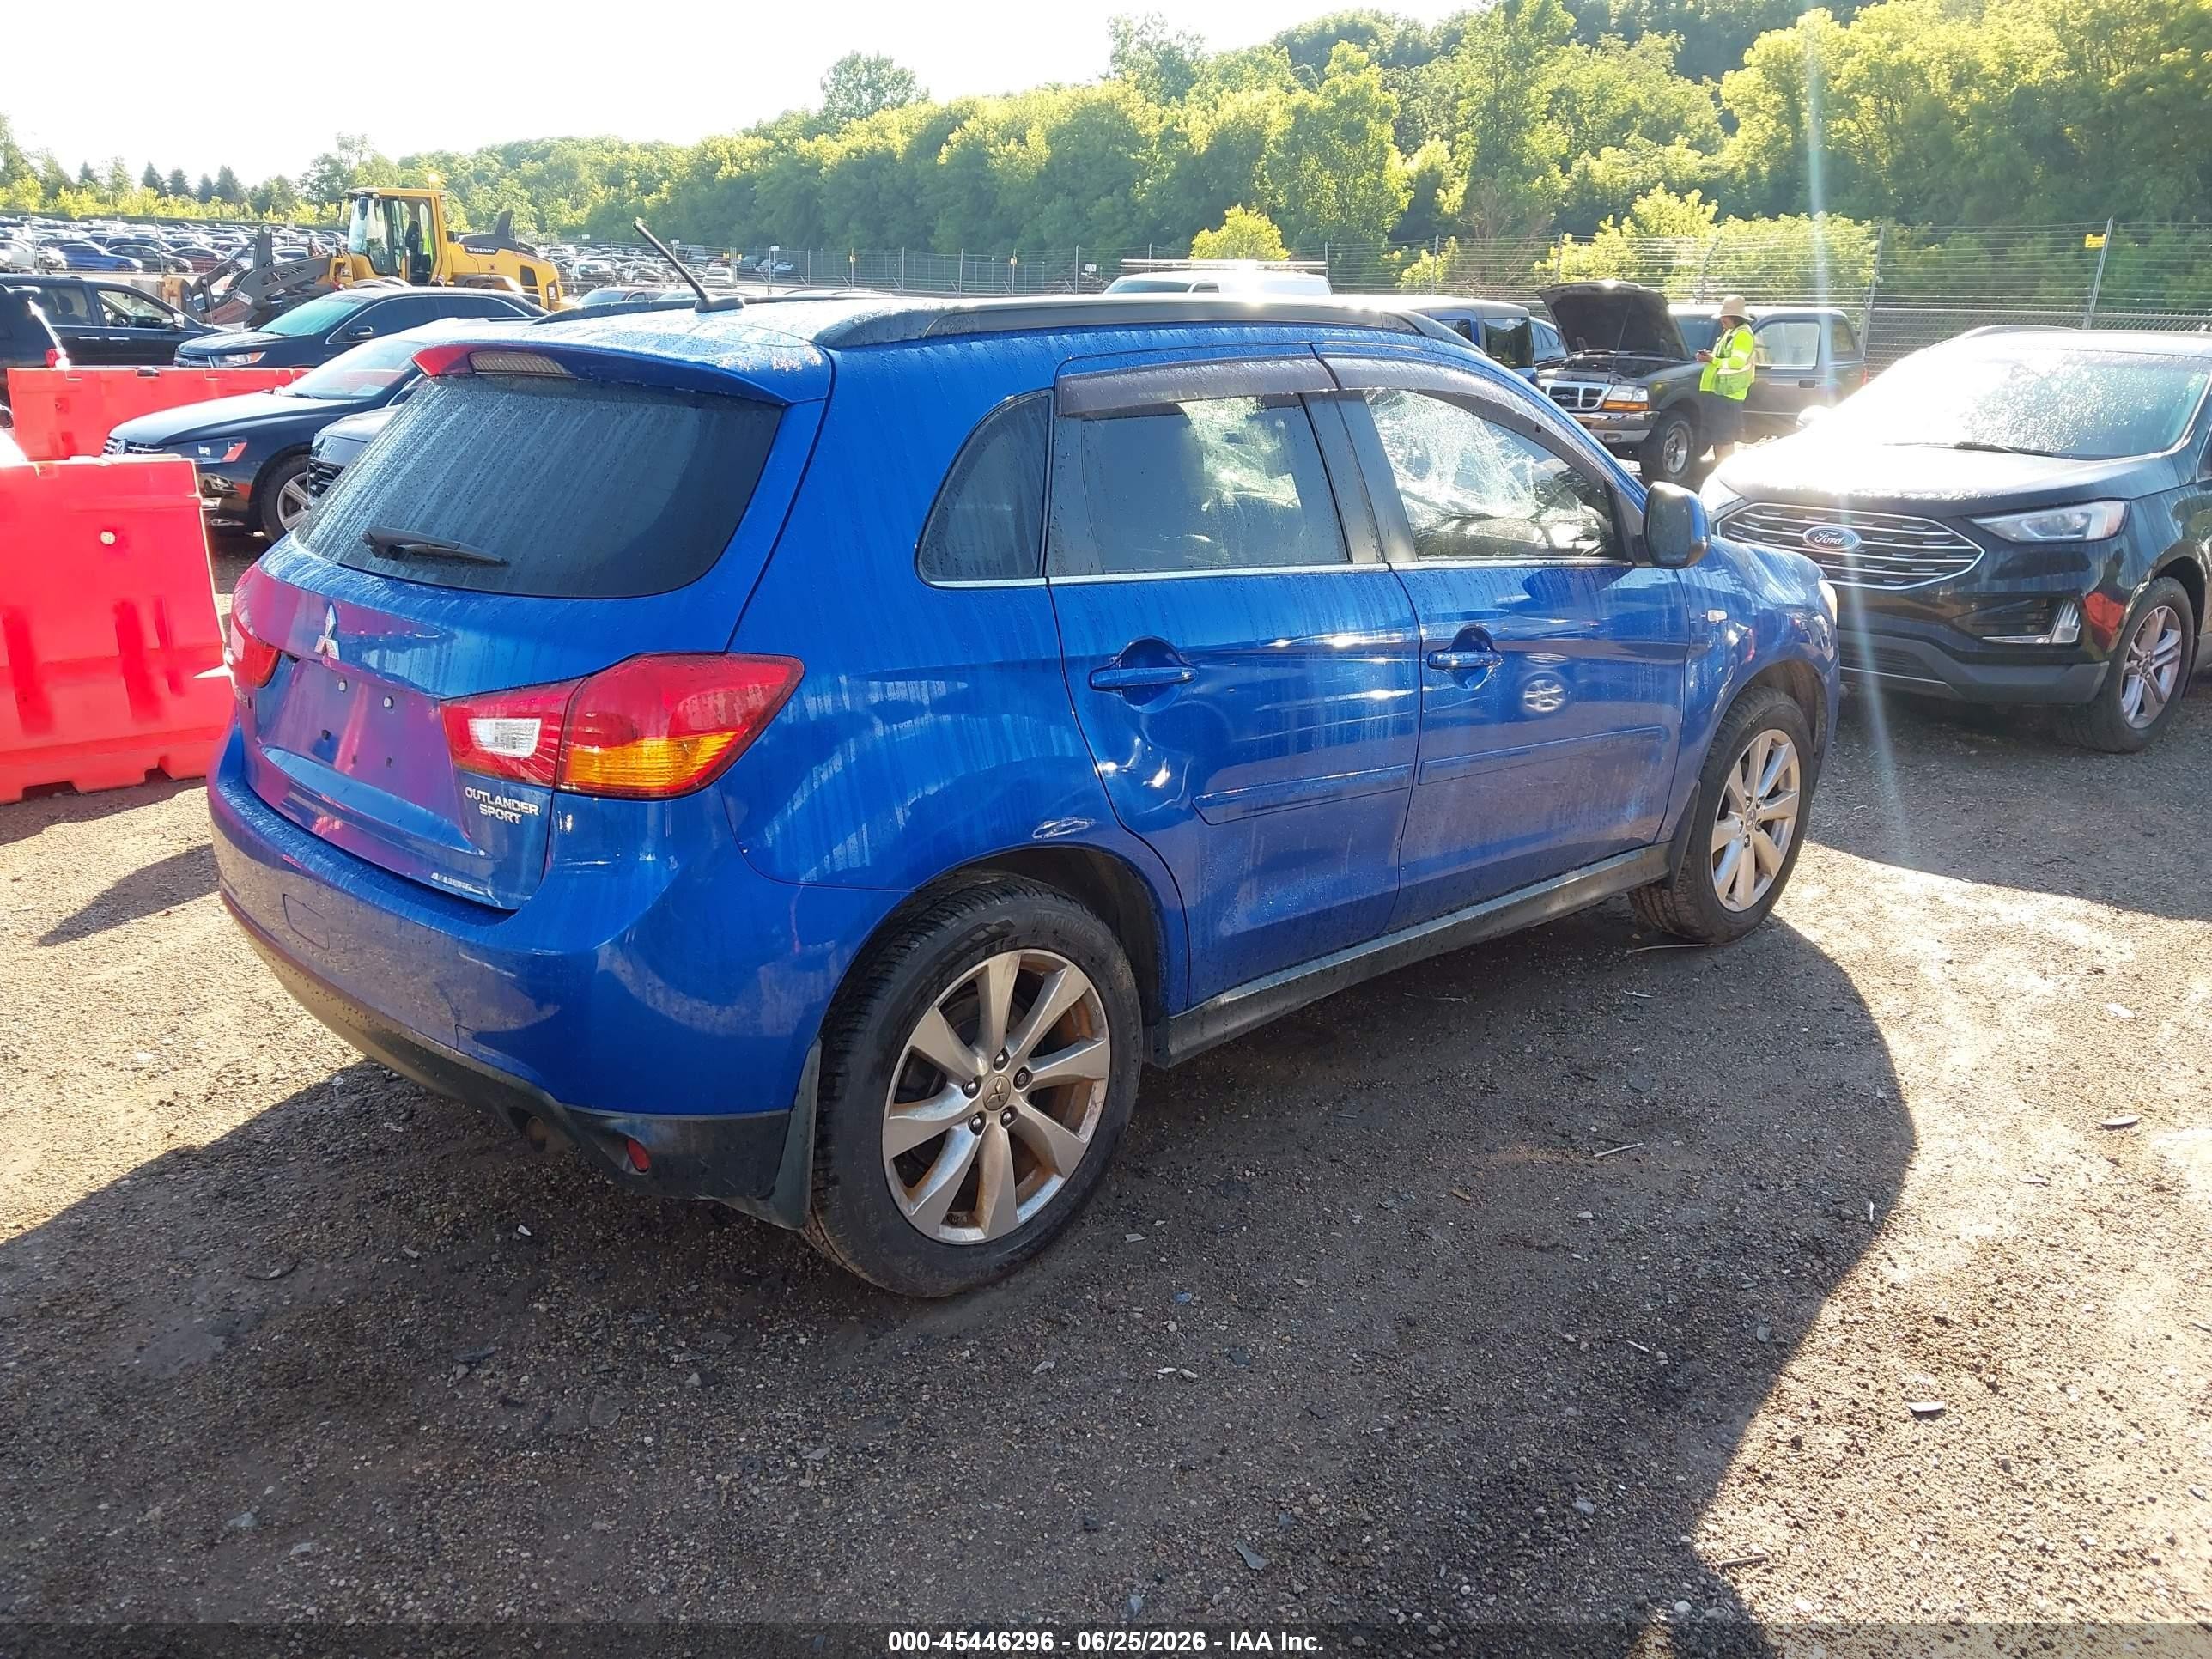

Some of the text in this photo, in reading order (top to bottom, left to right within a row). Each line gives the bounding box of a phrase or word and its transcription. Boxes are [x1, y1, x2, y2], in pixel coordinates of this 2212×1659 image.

[1814, 530, 1844, 545] Ford
[465, 787, 540, 816] OUTLANDER
[479, 804, 522, 824] SPORT
